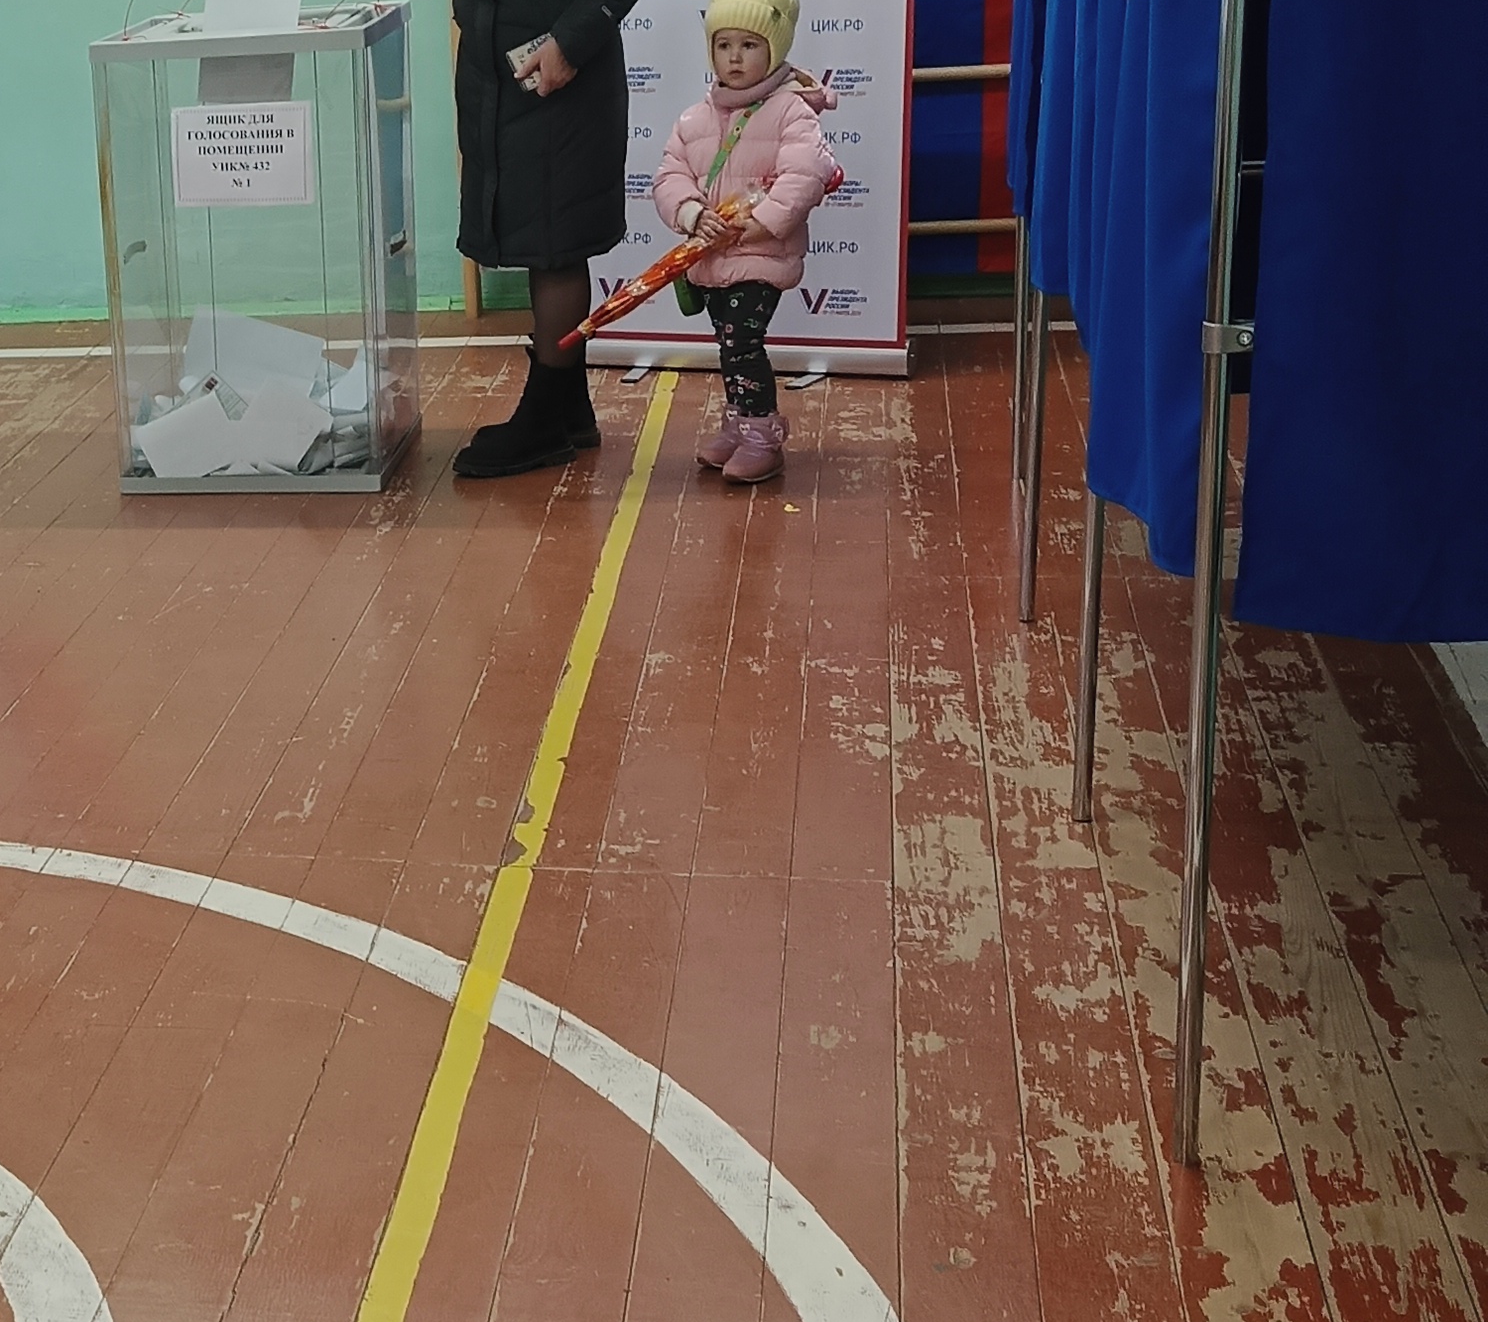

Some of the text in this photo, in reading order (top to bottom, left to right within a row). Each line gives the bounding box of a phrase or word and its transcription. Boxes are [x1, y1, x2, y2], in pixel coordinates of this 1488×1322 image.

[621, 18, 653, 31] К.РФ
[811, 18, 864, 35] ЦИК.РФ
[206, 114, 274, 126] ЯЩИК ДЛЯ
[187, 129, 295, 141] ГОЛОСОВАНИЯ В
[198, 144, 284, 156] ПОМЕЩЕНИИ
[252, 161, 270, 171] 432
[619, 232, 652, 245] К.РФ
[807, 240, 859, 256] ЦИК.РФ
